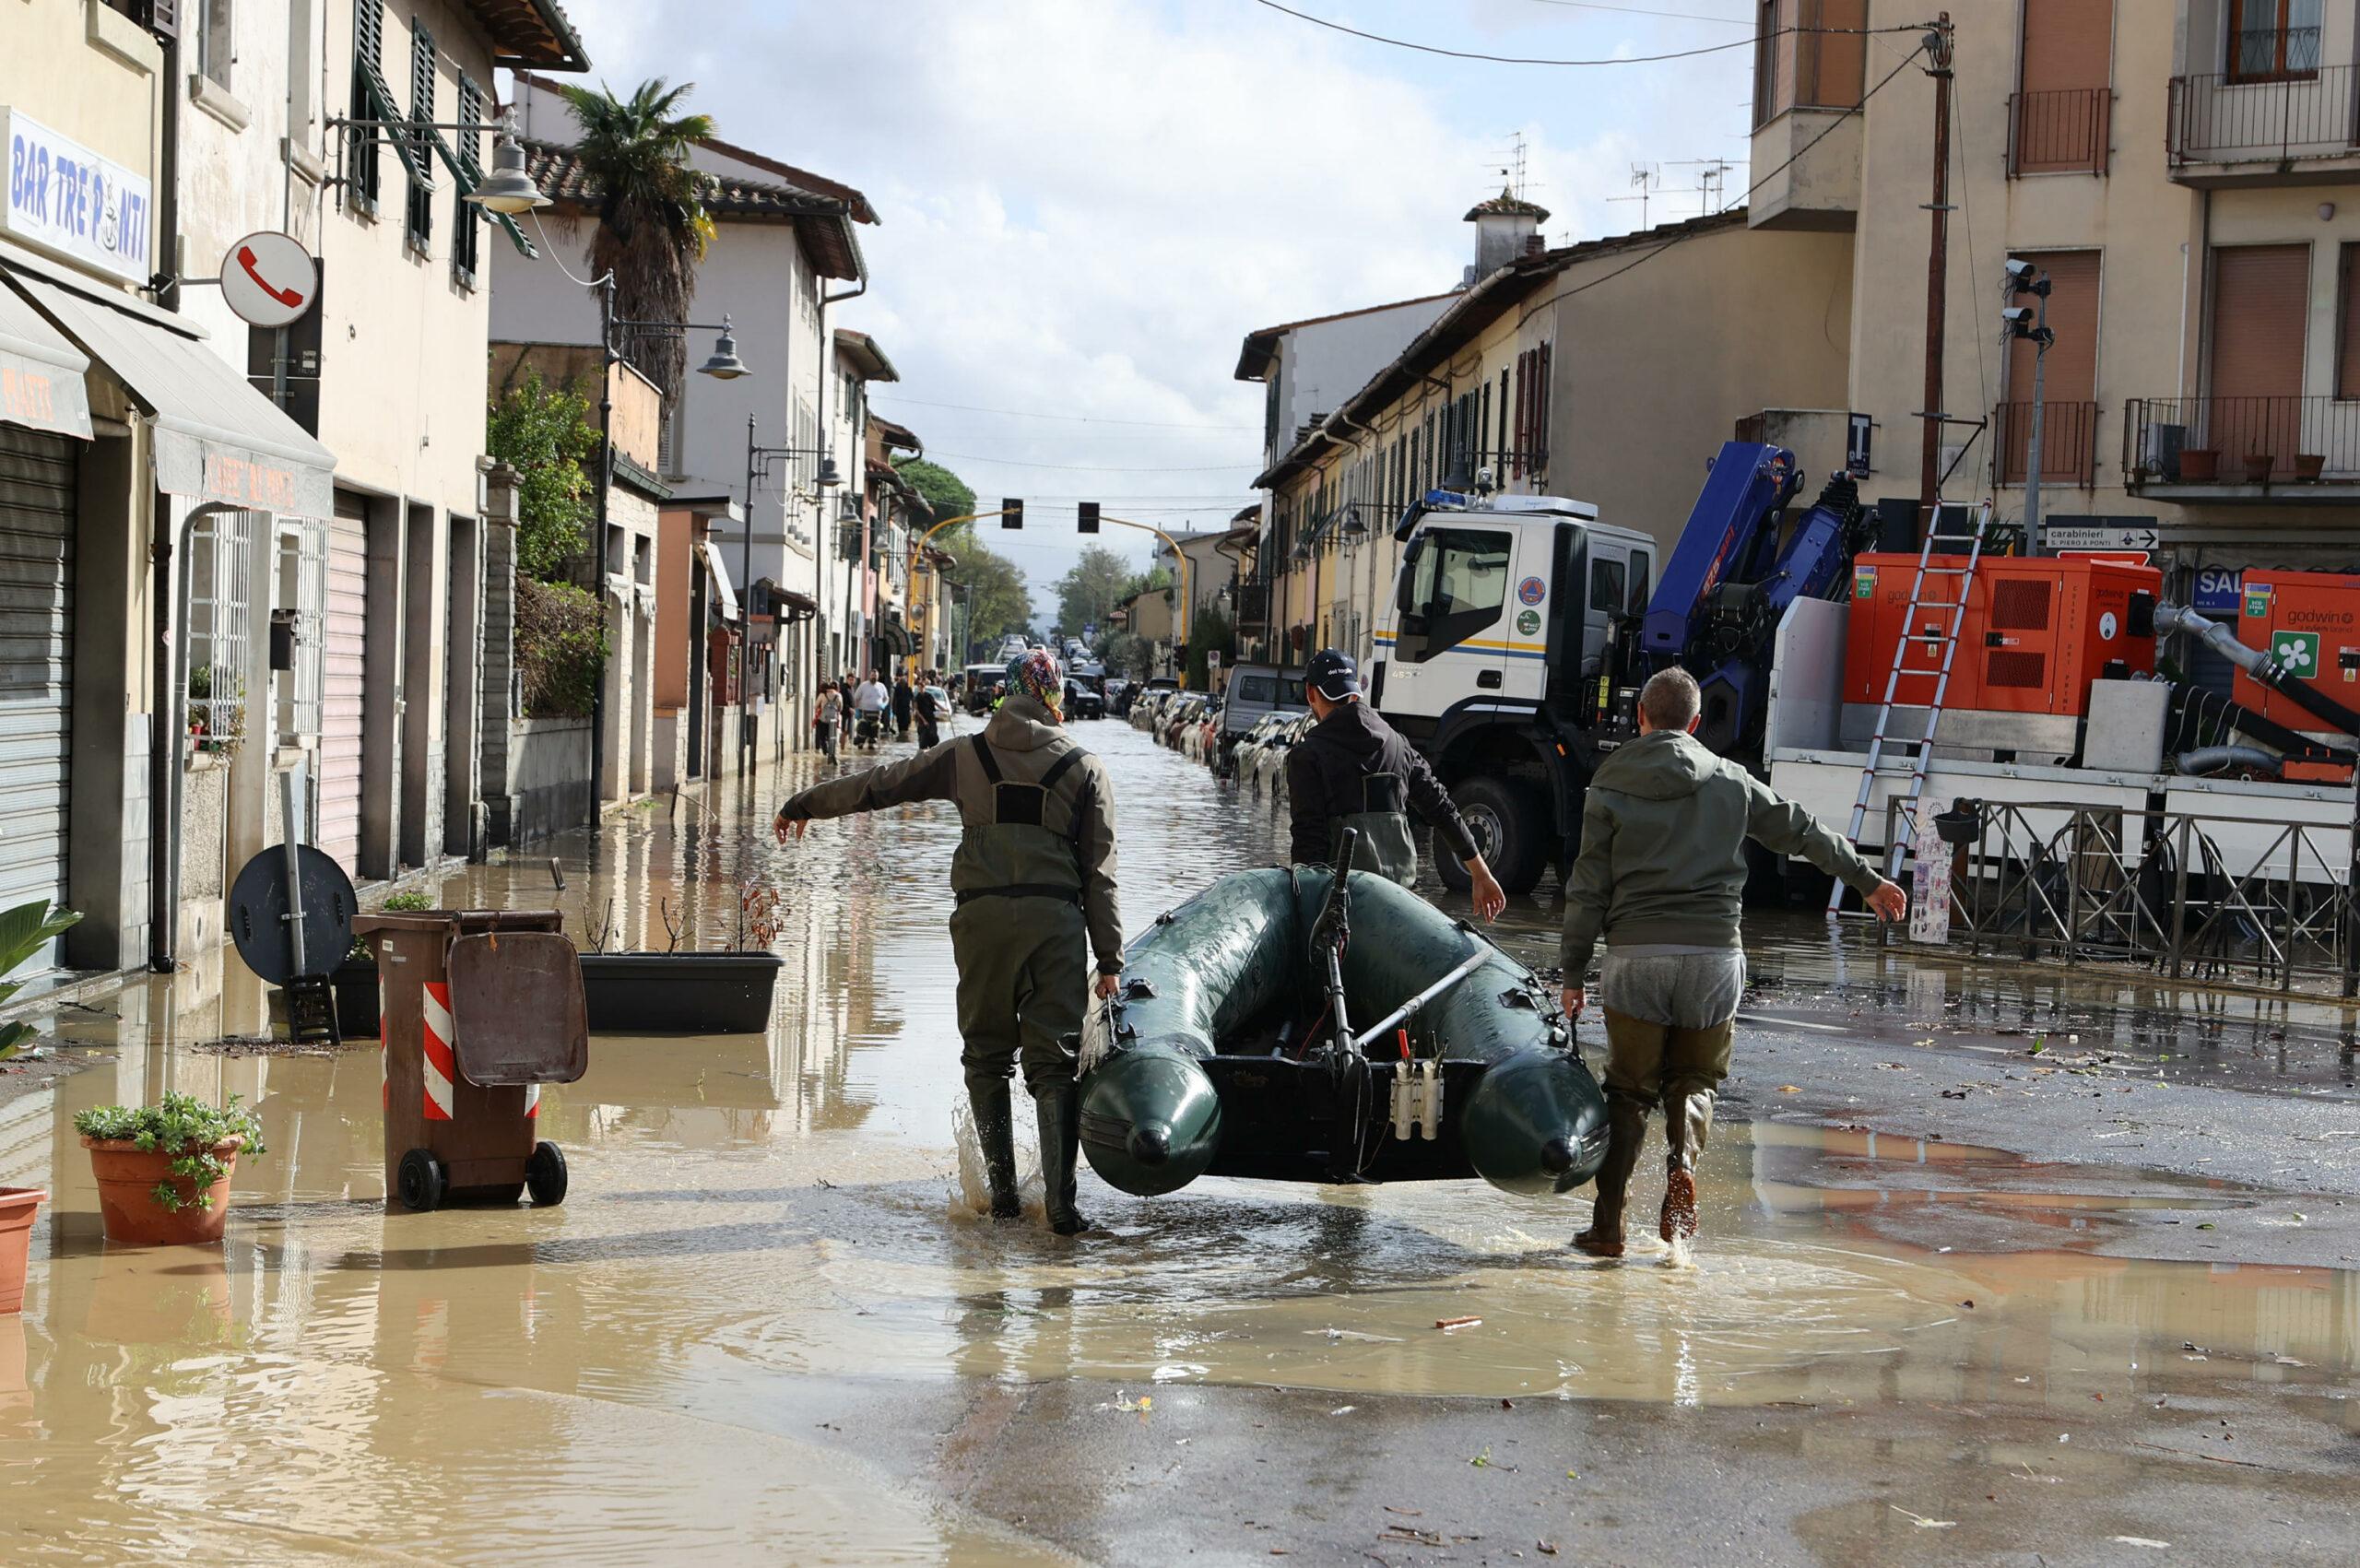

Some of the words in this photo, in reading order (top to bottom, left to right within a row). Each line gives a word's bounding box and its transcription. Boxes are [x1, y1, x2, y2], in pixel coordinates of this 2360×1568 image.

[12, 135, 49, 226] BAR
[56, 155, 88, 238] TRE
[2051, 529, 2104, 538] carabinieri
[2288, 609, 2340, 625] godwin
